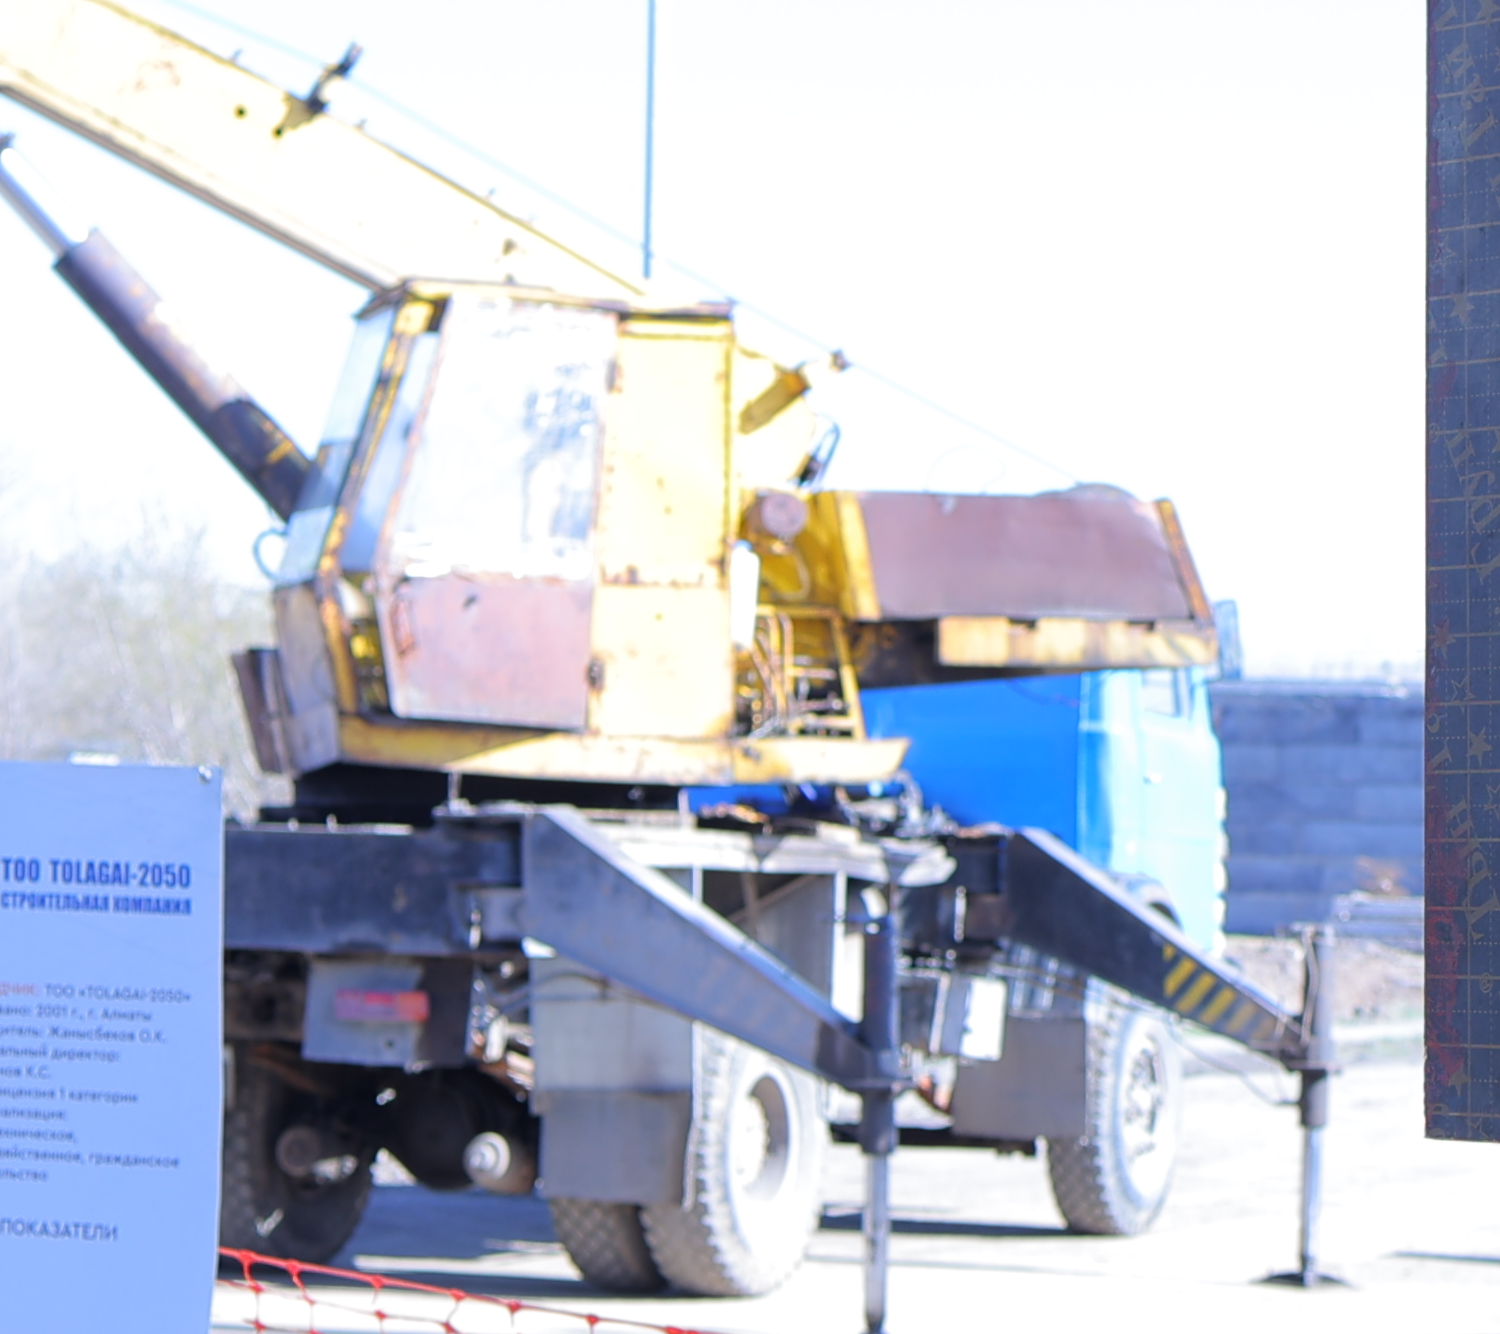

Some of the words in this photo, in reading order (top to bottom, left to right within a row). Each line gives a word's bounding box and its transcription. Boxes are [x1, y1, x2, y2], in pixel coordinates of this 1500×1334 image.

[1, 857, 41, 883] ТОО
[50, 858, 192, 889] TOLAGAI-2050
[44, 984, 76, 998] ТОО
[0, 1217, 118, 1241] ПОКАЗАТЕЛИ
